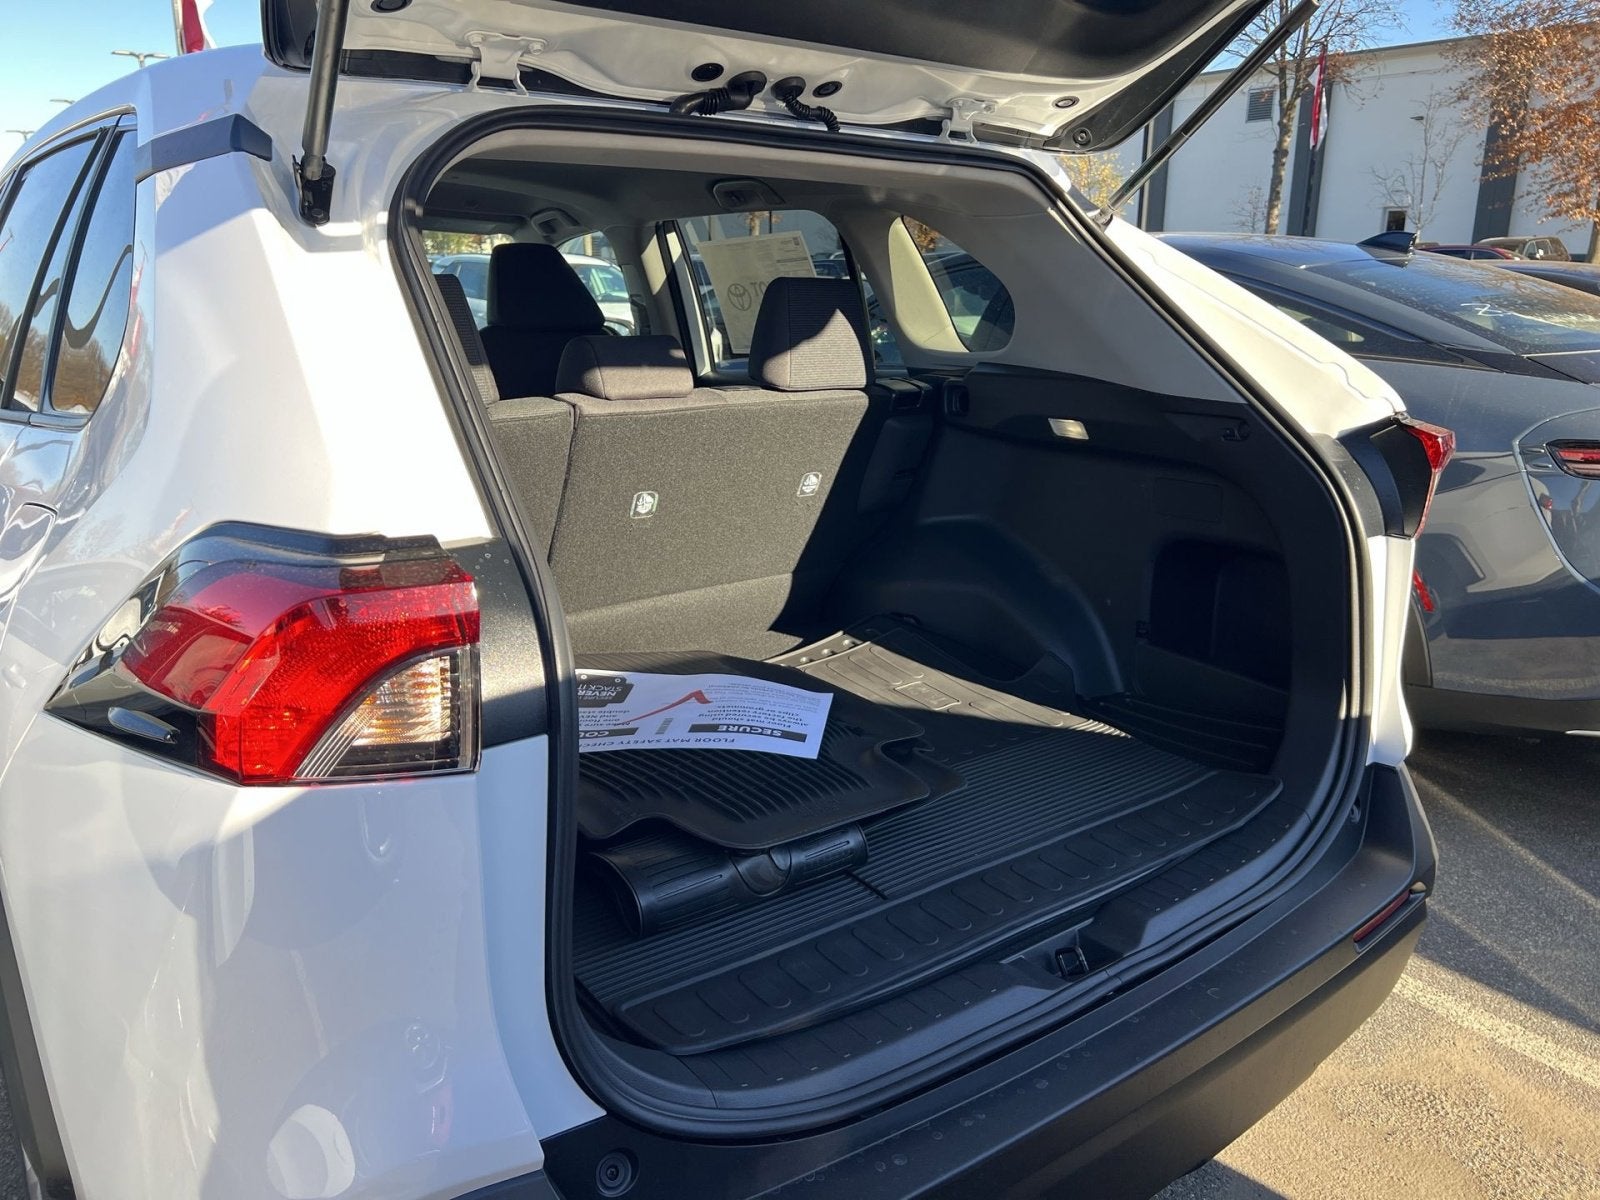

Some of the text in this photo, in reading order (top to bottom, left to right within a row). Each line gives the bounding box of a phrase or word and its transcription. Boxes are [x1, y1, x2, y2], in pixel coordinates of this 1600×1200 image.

[753, 712, 783, 720] factory
[779, 718, 808, 727] always
[716, 725, 782, 736] SECURE
